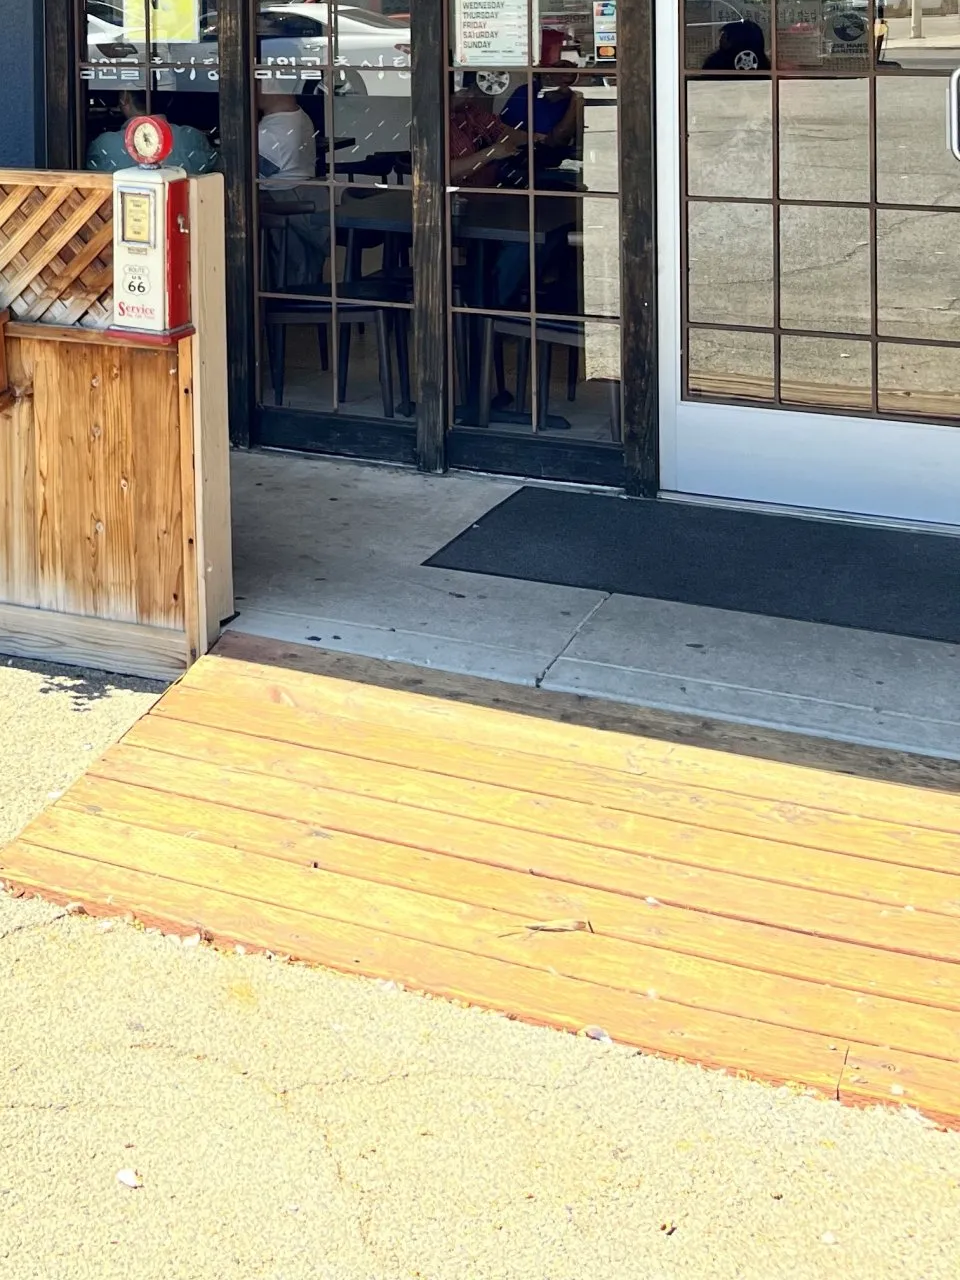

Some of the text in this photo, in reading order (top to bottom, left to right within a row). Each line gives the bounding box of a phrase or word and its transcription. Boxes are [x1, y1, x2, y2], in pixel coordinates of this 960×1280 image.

[462, 1, 505, 10] WEDNESDAY
[463, 11, 499, 19] THURSDAY
[463, 21, 487, 29] FRIDAY
[463, 31, 499, 39] SATURDAY
[463, 41, 492, 49] SUNDAY
[128, 280, 146, 293] 66
[118, 301, 156, 317] Service
